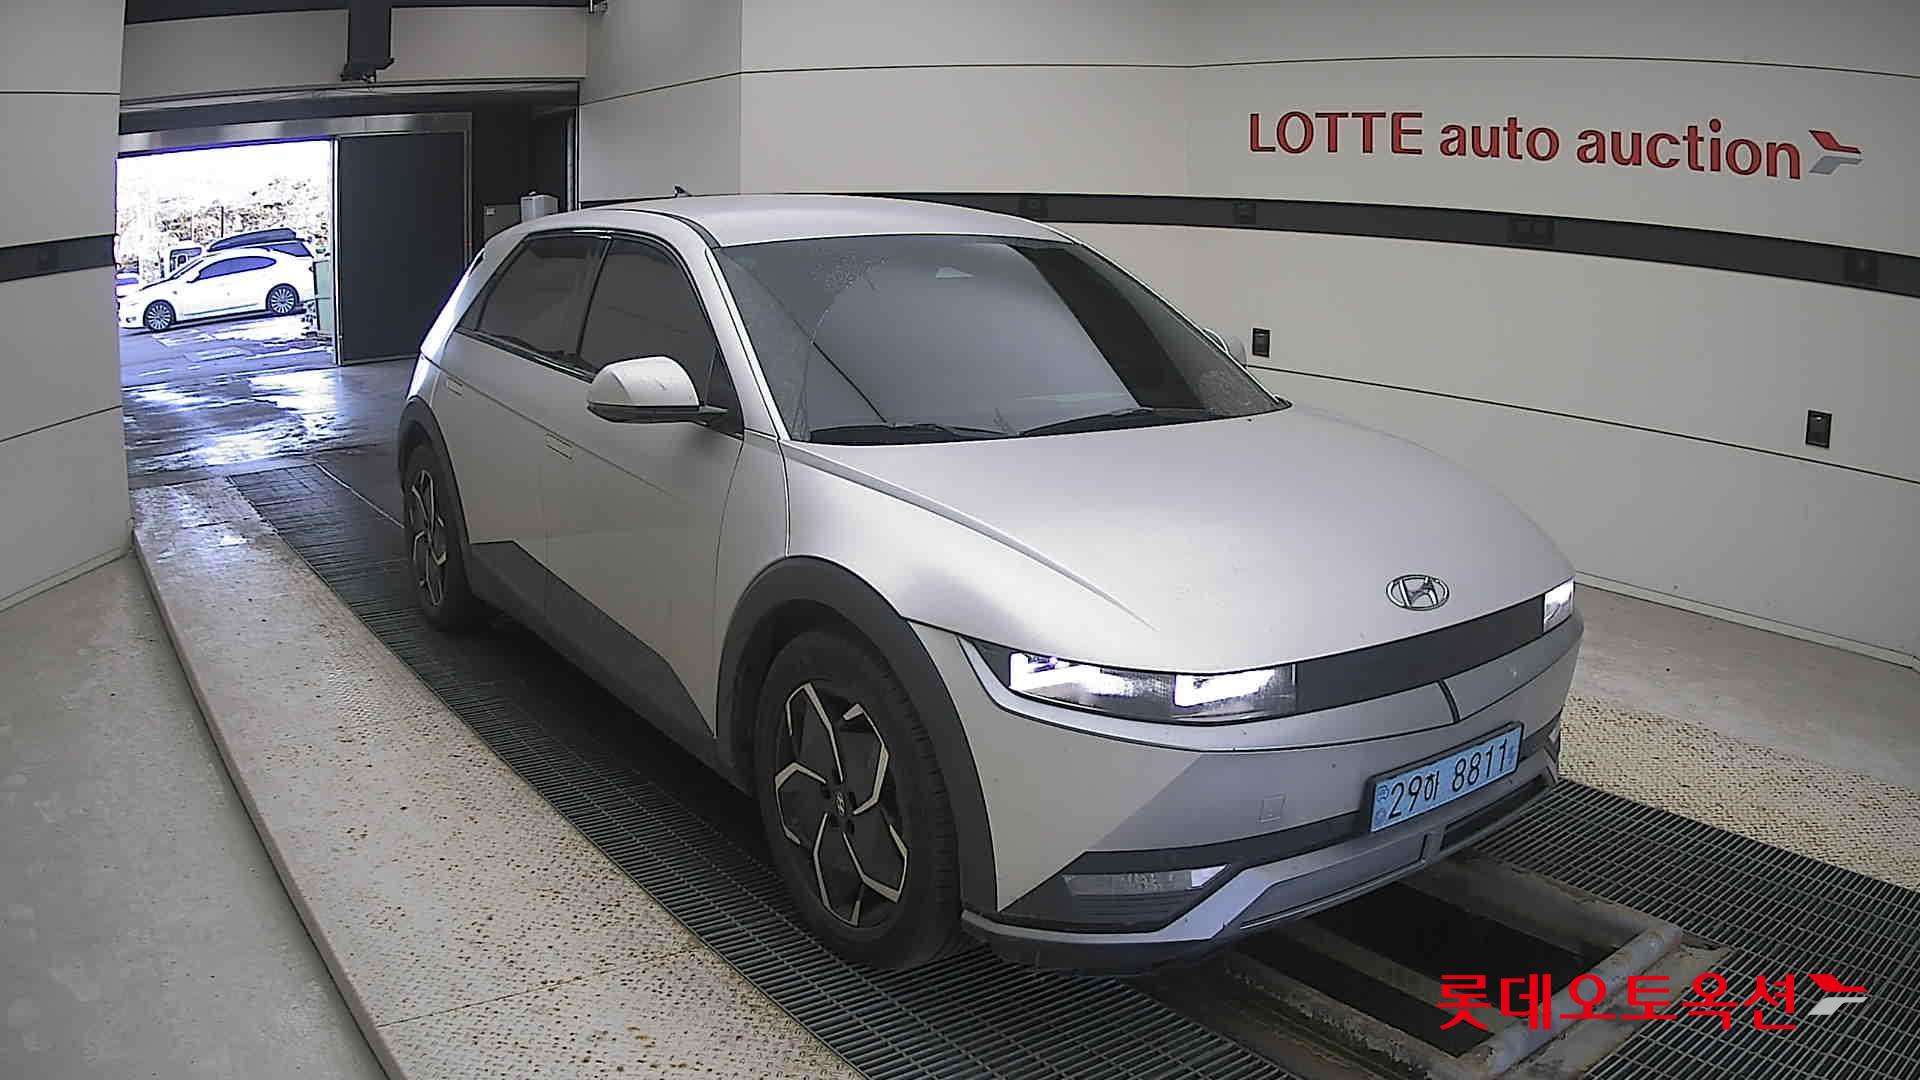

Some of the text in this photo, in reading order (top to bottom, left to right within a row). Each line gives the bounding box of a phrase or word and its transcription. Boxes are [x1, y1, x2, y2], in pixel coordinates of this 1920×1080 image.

[1249, 112, 1801, 180] LOTTE auto auction
[1388, 738, 1508, 820] 29하 8811
